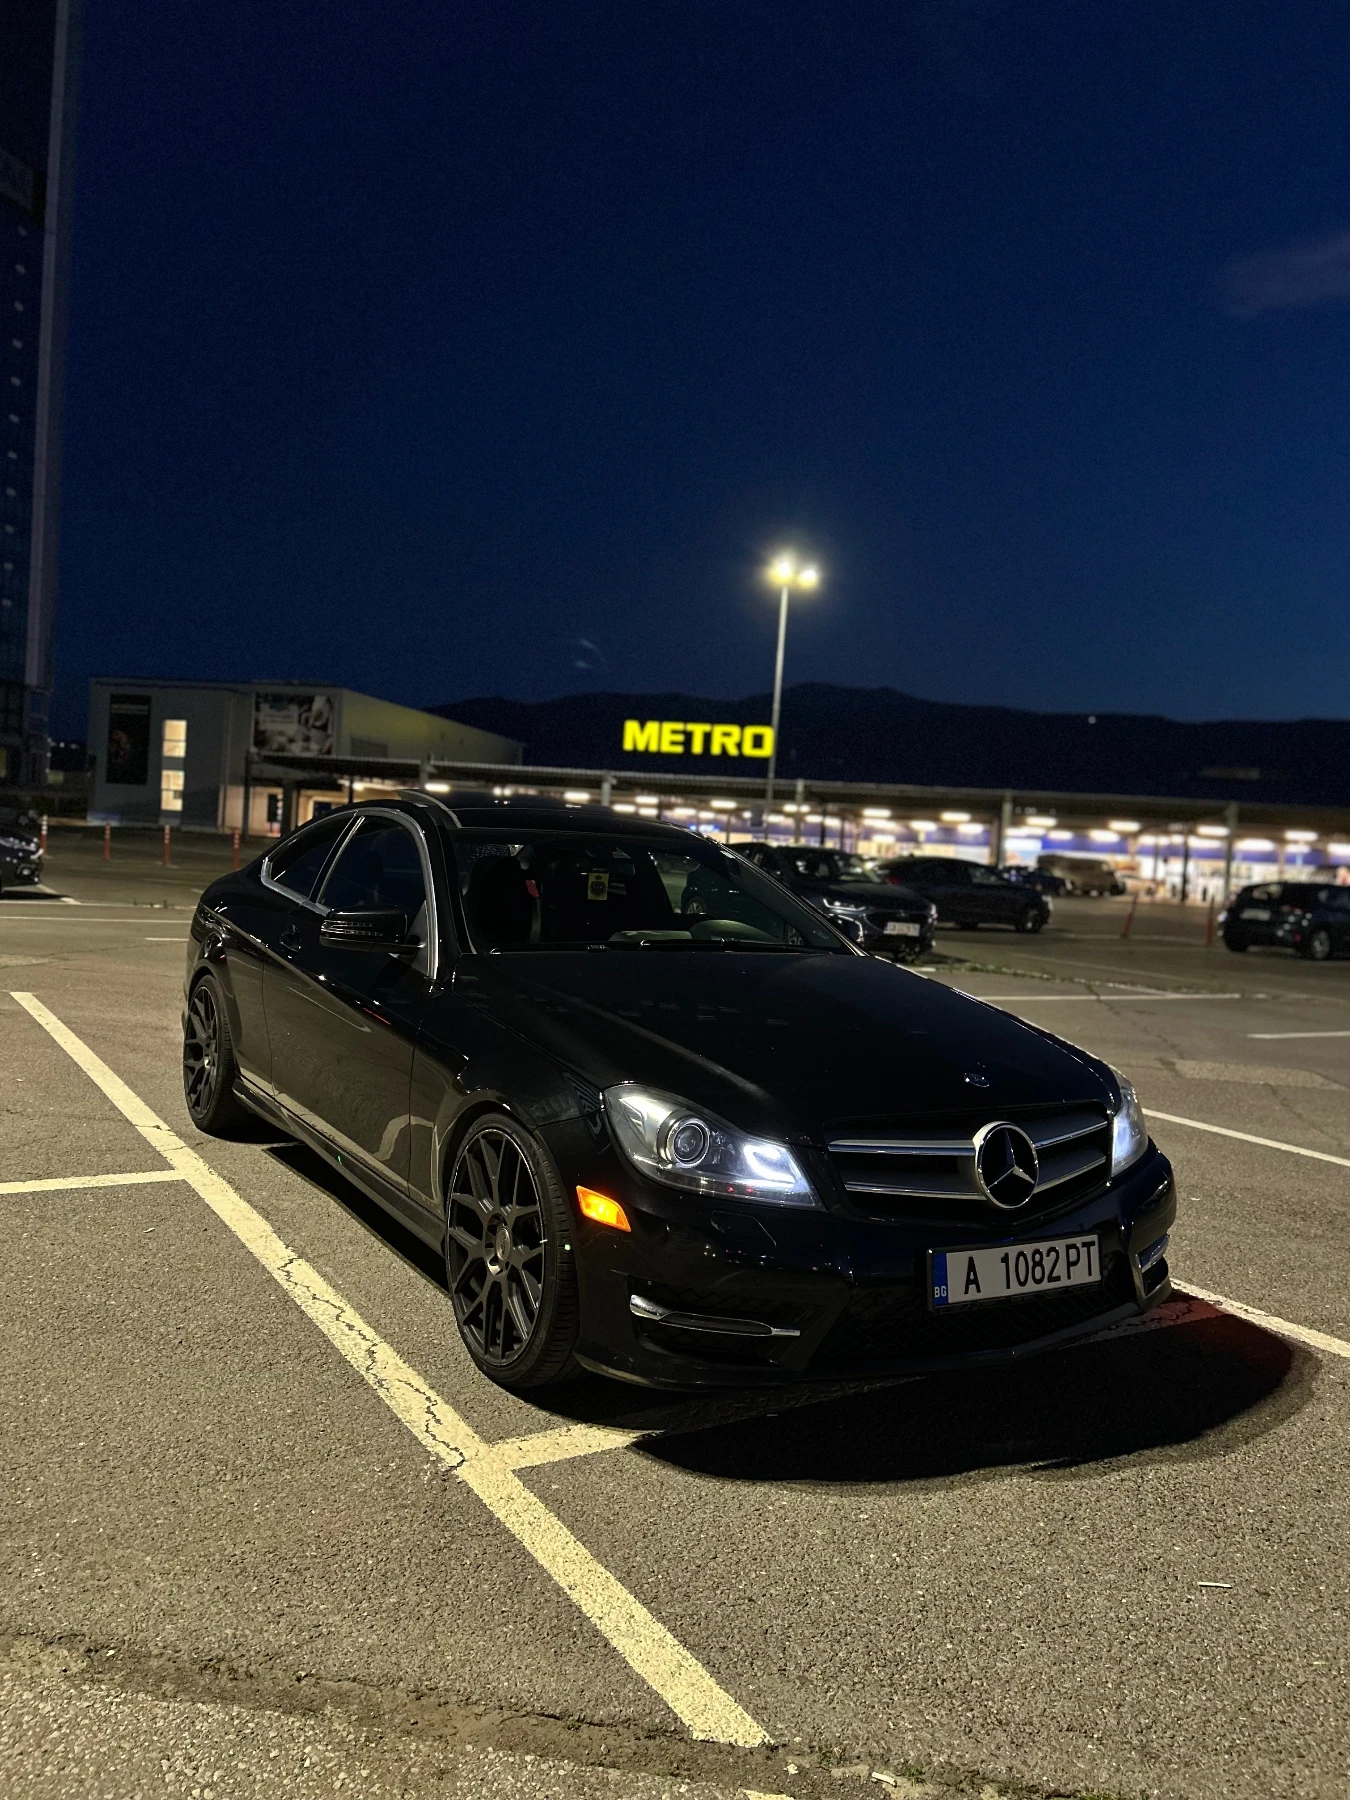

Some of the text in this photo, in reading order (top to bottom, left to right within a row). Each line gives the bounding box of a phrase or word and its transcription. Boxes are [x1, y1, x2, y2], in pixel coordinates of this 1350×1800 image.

[622, 719, 775, 758] METRO
[934, 1285, 947, 1298] BG
[964, 1256, 981, 1295] A
